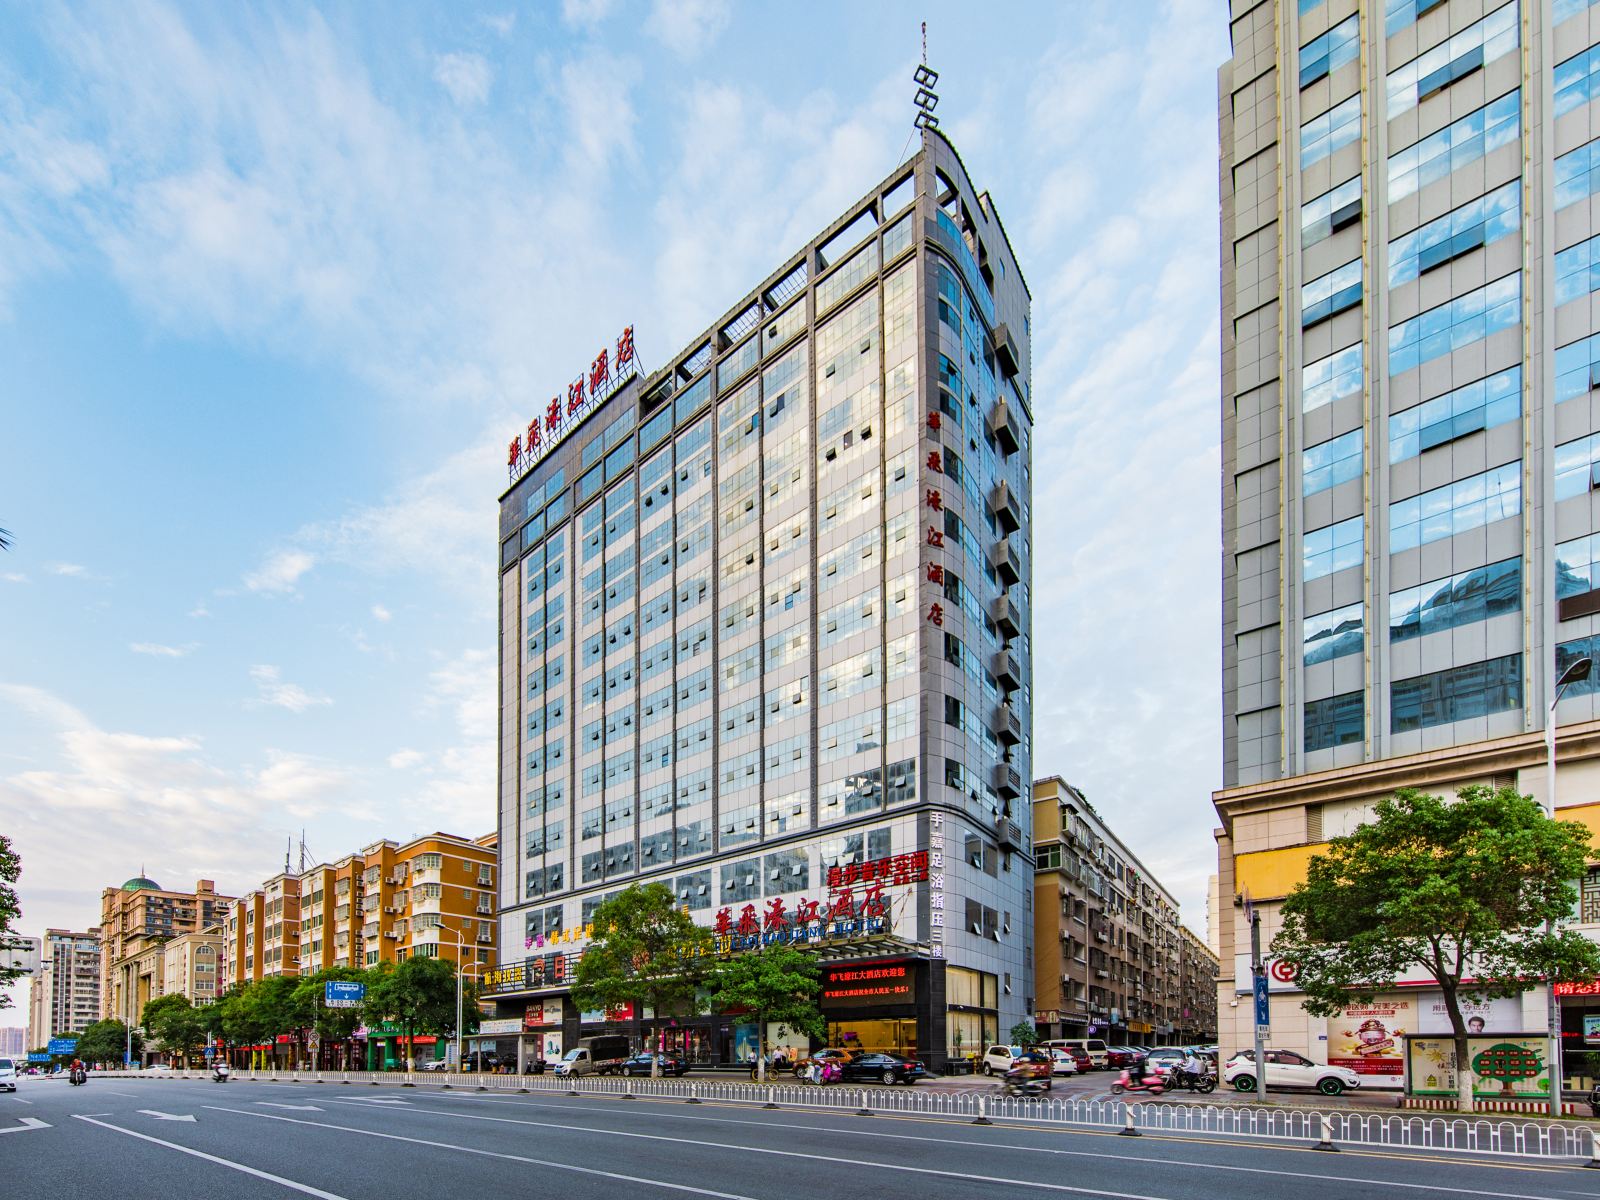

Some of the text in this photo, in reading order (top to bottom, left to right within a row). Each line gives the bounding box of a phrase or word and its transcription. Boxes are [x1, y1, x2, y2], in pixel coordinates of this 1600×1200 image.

[827, 851, 929, 888] 漫步音乐空间
[834, 917, 883, 936] HOTEL
